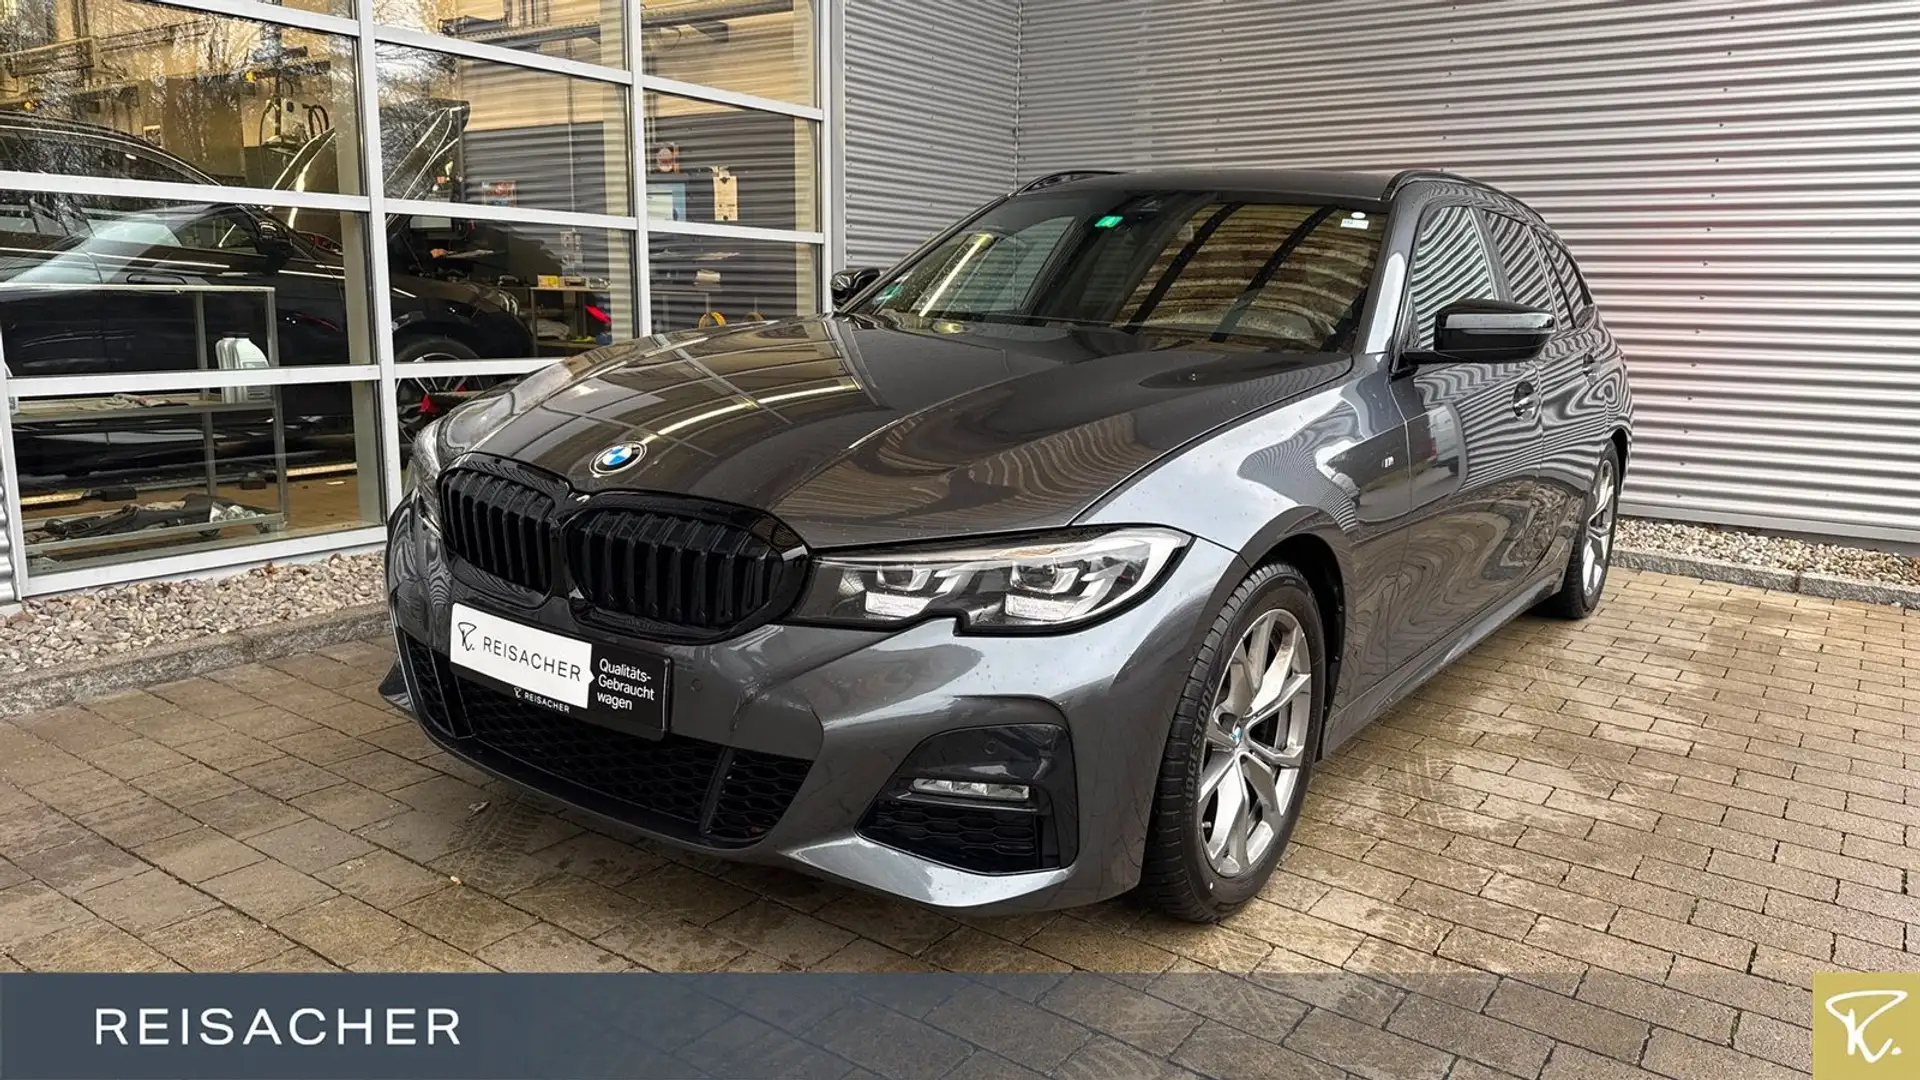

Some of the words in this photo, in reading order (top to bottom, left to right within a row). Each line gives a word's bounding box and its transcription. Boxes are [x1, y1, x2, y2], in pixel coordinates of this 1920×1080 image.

[483, 636, 581, 682] REISACHER
[599, 658, 652, 682] Qualitäts-
[598, 675, 655, 701] Gebraucht
[524, 691, 570, 714] REISACHER
[597, 692, 633, 711] wagen
